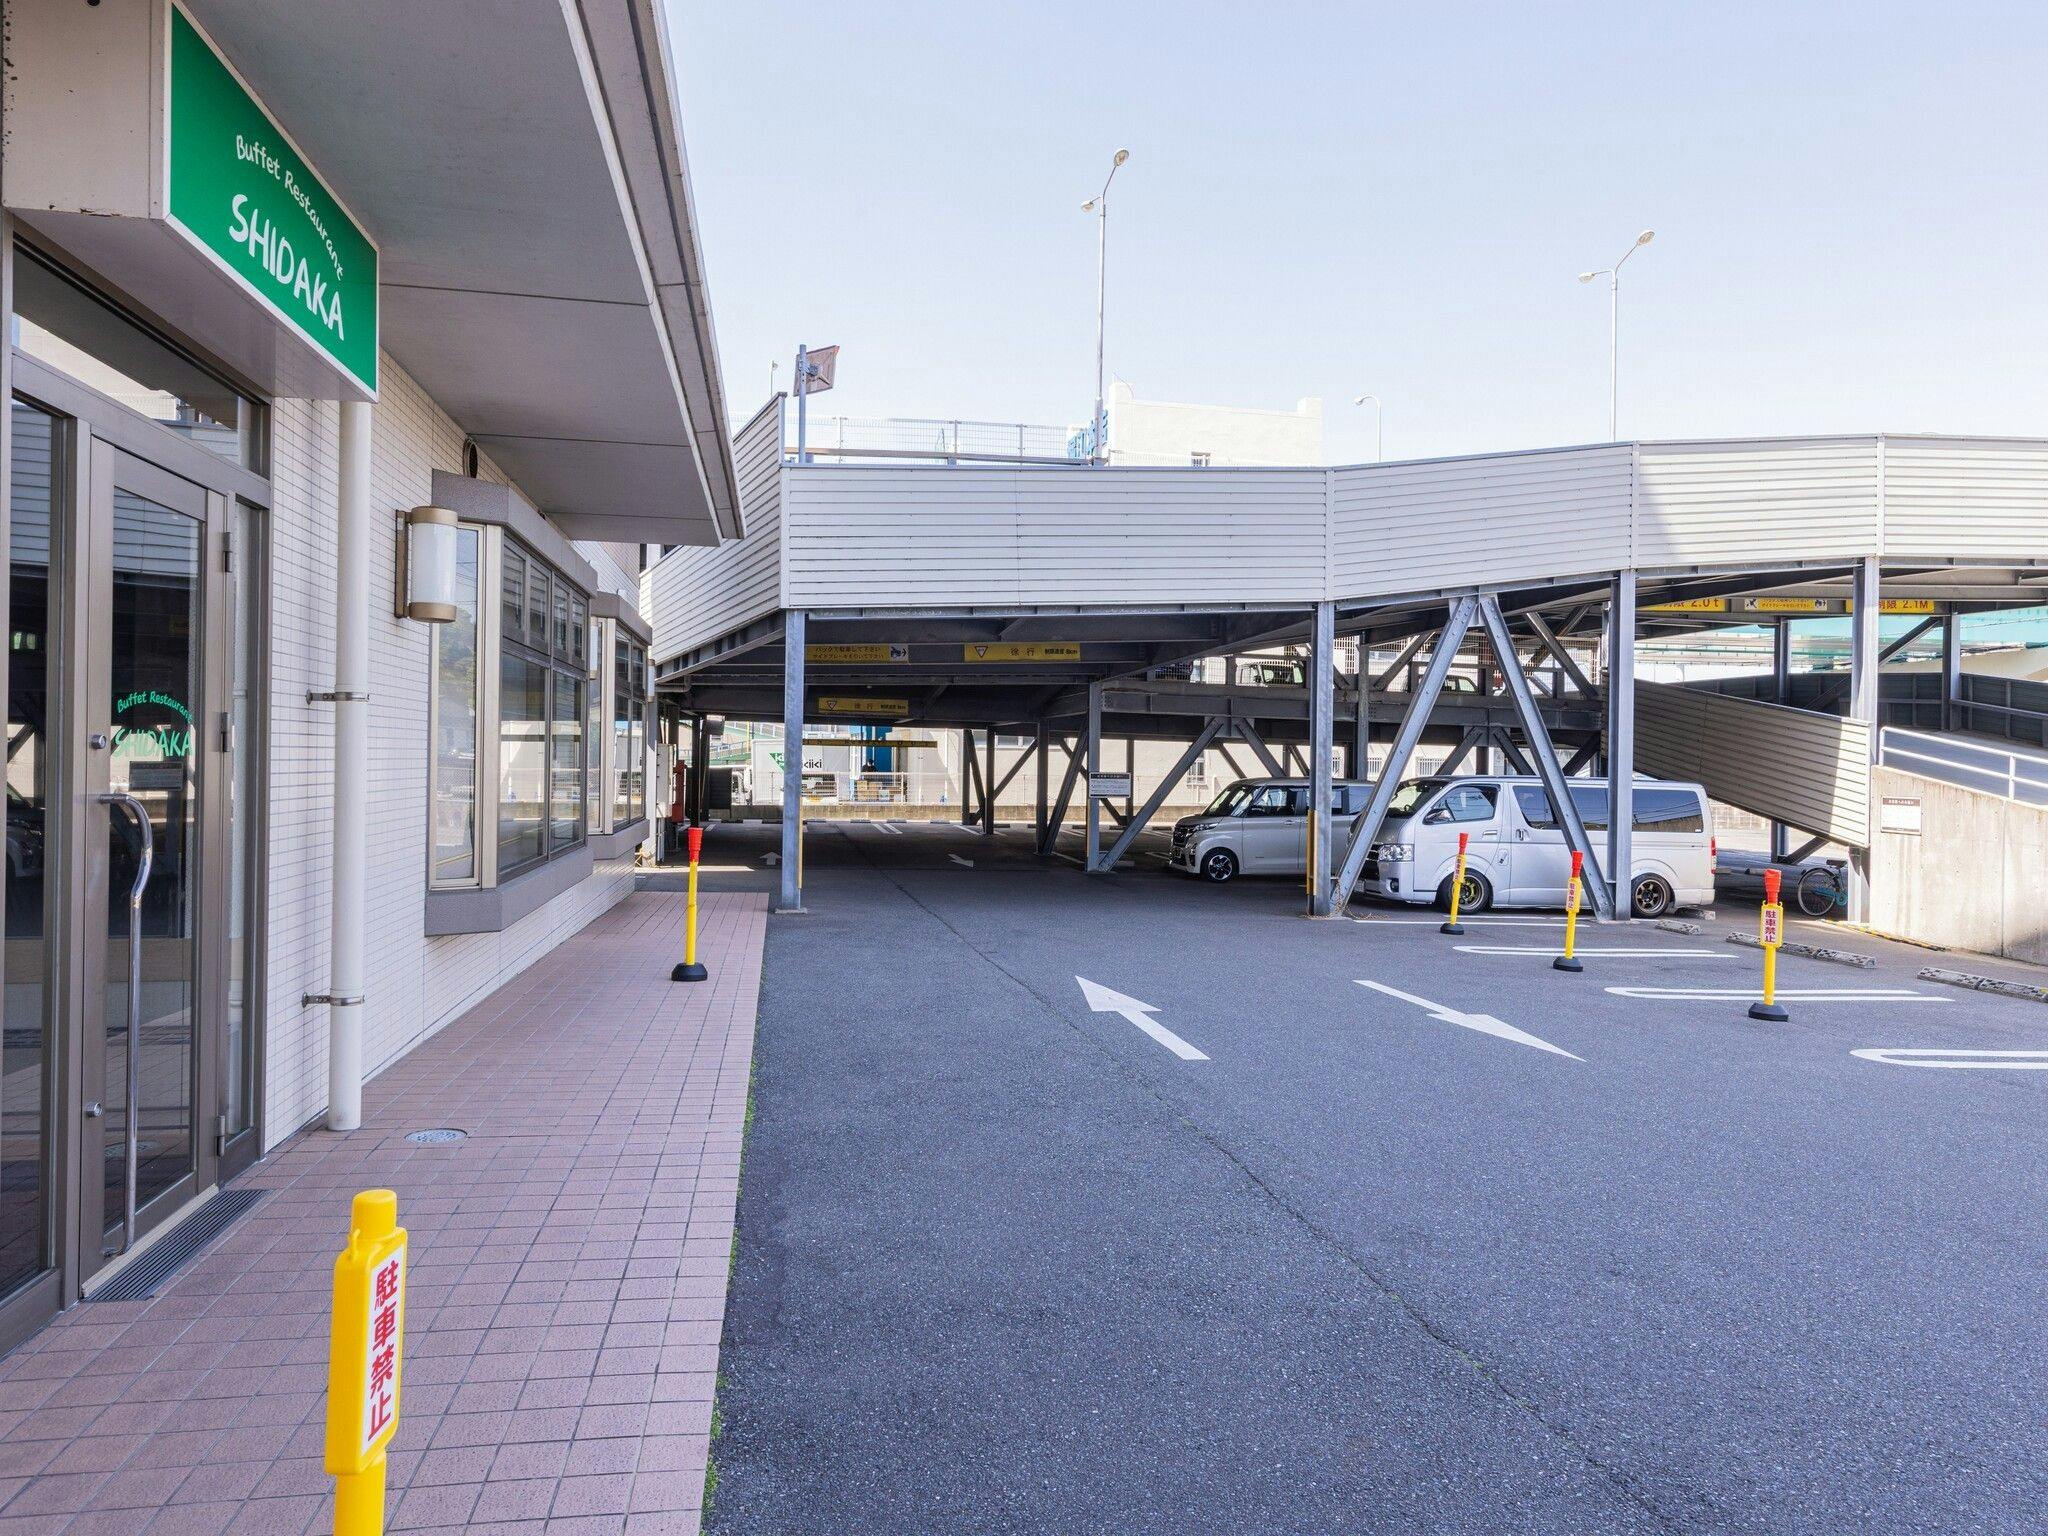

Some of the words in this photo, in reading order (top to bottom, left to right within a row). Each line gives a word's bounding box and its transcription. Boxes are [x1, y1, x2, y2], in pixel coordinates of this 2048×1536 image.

[235, 134, 281, 180] Buffet
[284, 169, 344, 282] Restaurant
[228, 193, 345, 341] SHIDAKA
[113, 728, 195, 758] SHIDAKA
[117, 691, 148, 714] Buffet
[1765, 910, 1777, 944] 駐車禁止
[367, 1259, 400, 1443] 駐車禁止
